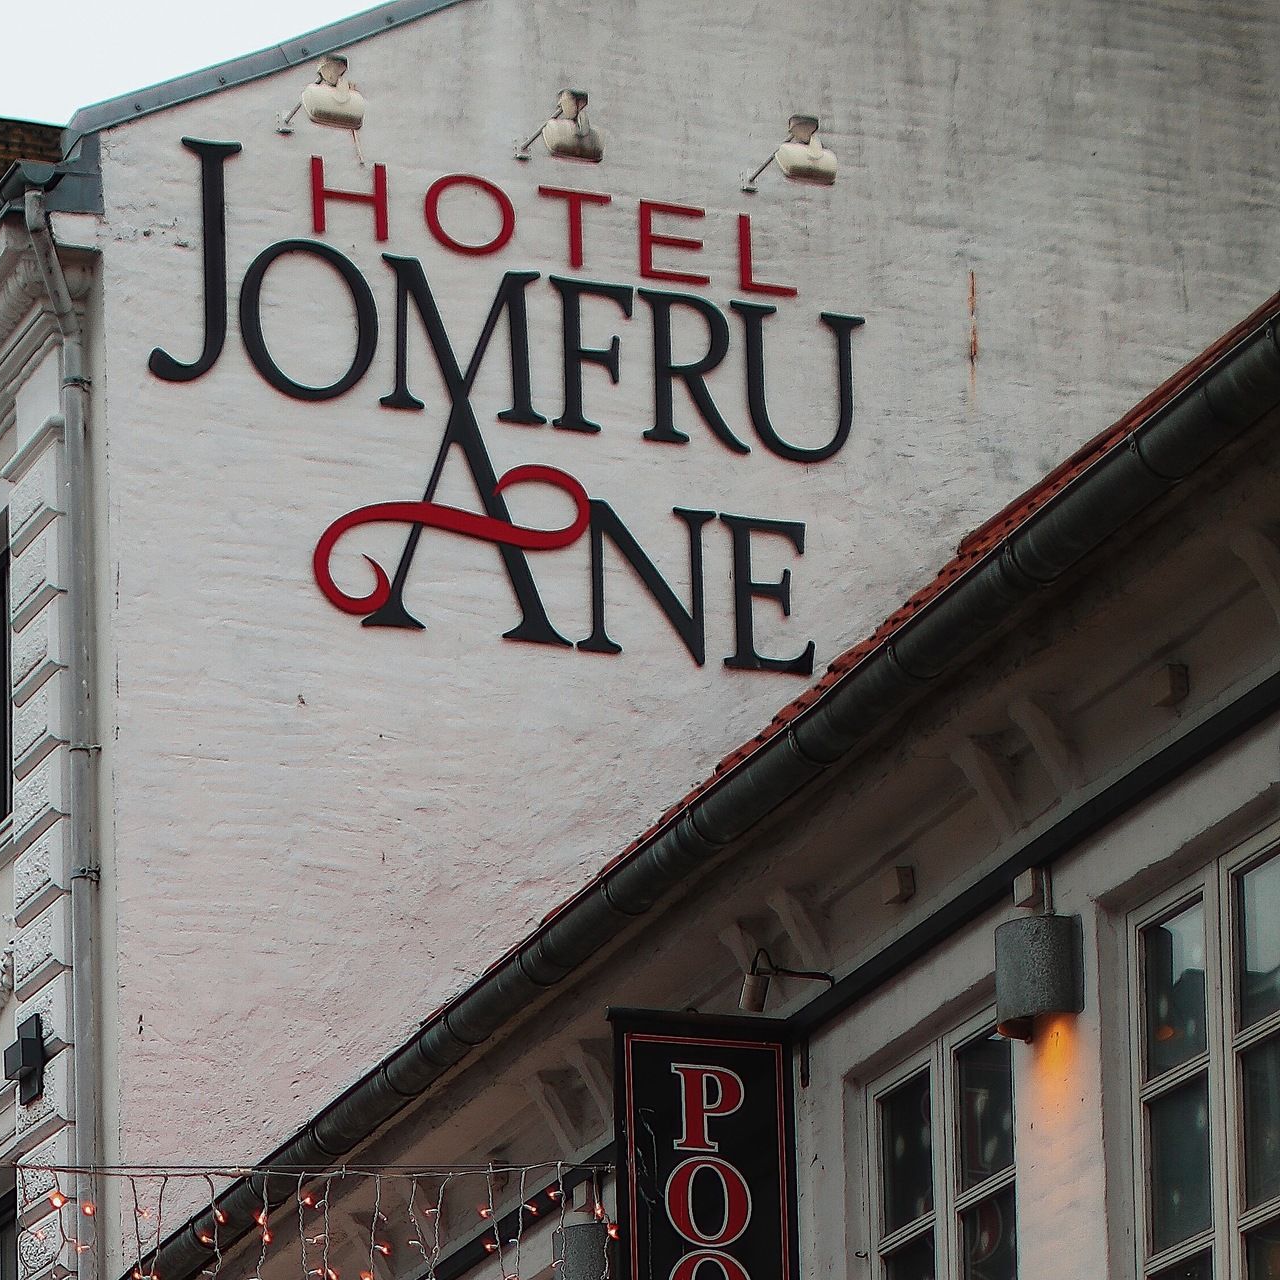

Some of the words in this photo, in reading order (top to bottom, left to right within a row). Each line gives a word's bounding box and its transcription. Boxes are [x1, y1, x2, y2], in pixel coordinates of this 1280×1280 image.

[147, 136, 866, 464] JOMFRU
[310, 154, 799, 296] HOTEL
[313, 398, 816, 676] ANE
